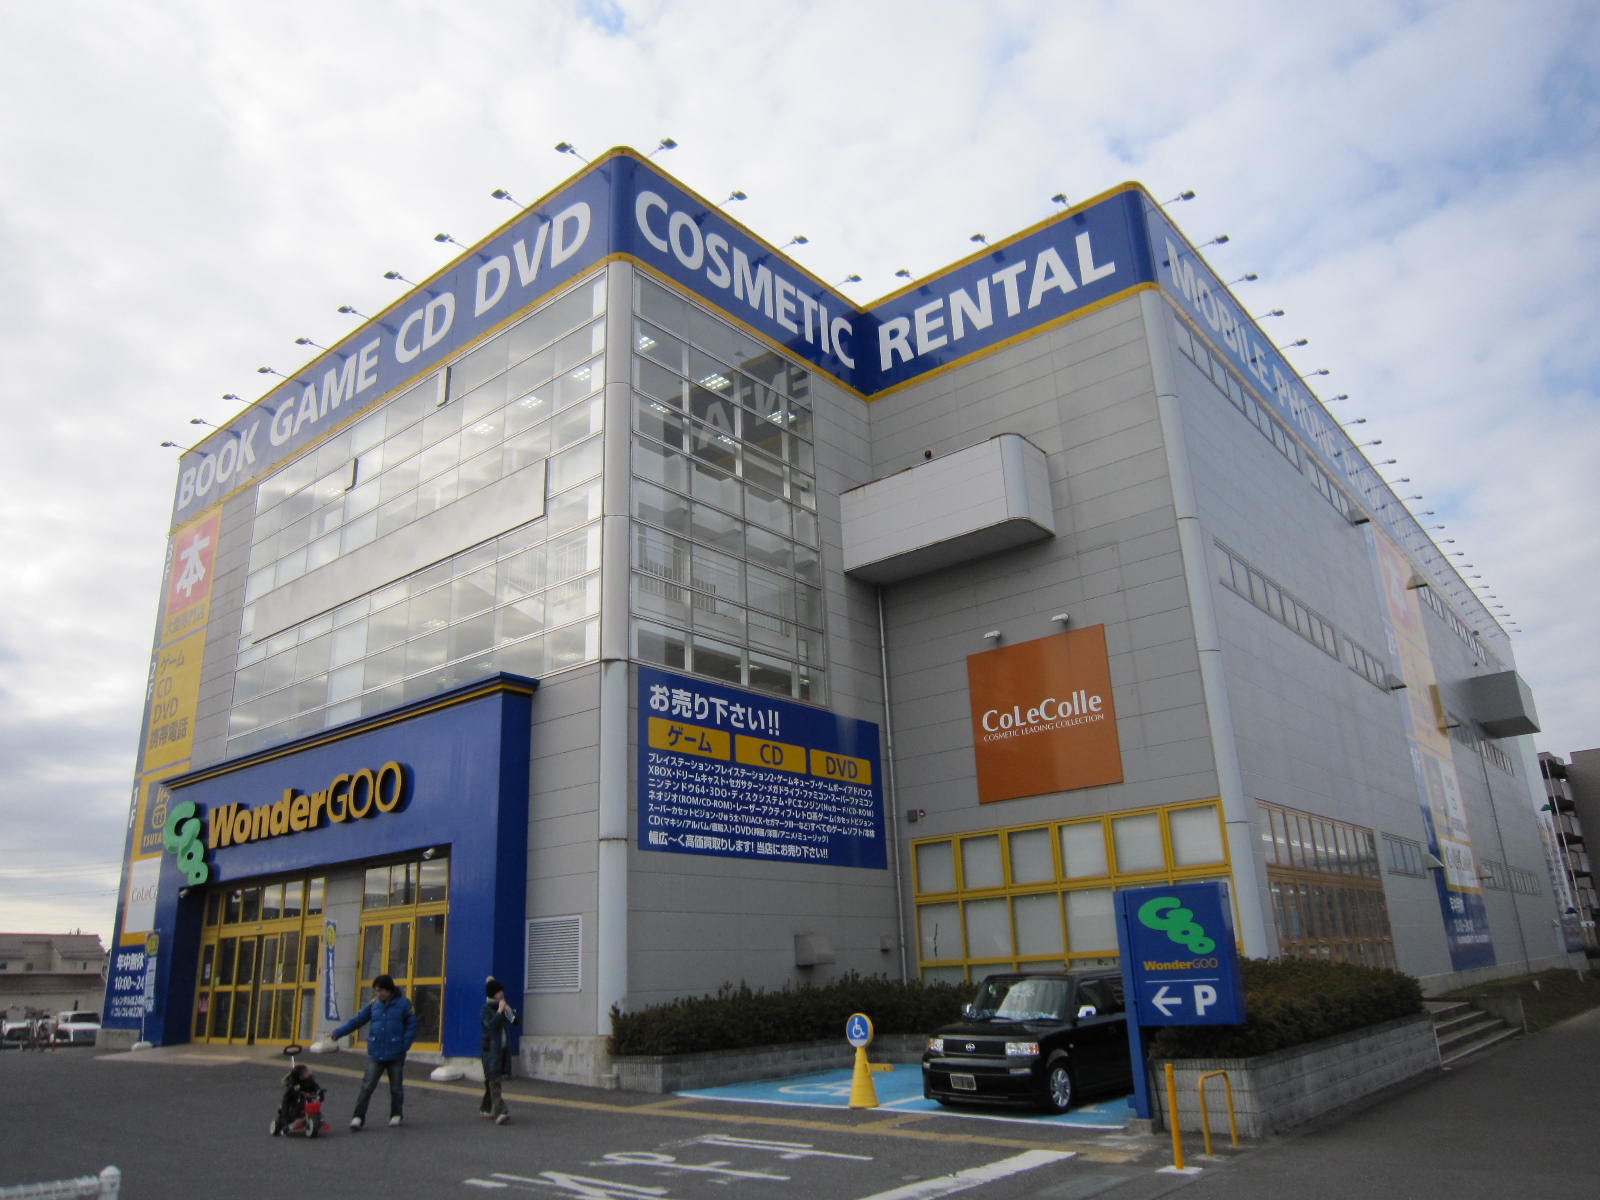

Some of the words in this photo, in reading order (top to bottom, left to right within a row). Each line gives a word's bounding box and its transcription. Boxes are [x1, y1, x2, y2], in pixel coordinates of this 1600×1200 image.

[634, 189, 856, 371] COSMETIC
[877, 231, 1117, 373] RENTAL
[1164, 236, 1273, 393] MOBILE
[177, 420, 258, 511] BOOK
[269, 334, 382, 447] GAME
[394, 291, 456, 364] CD
[474, 201, 593, 318] DVD
[176, 533, 210, 598] 本
[159, 650, 186, 676] ゲーム
[146, 661, 157, 702] 2F
[156, 675, 173, 700] CD
[153, 697, 179, 724] DVD
[982, 690, 1103, 732] CoLeColle
[983, 729, 1020, 743] COSMETIC
[1021, 722, 1054, 736] LEADING
[1055, 713, 1105, 729] COLLECTION
[667, 725, 712, 753] ゲーム
[759, 743, 784, 766] CD
[826, 756, 859, 779] DVD
[129, 786, 139, 829] 1F
[209, 761, 402, 849] WonderGOO
[1143, 957, 1218, 971] WonderGOO
[1193, 984, 1217, 1016] P
